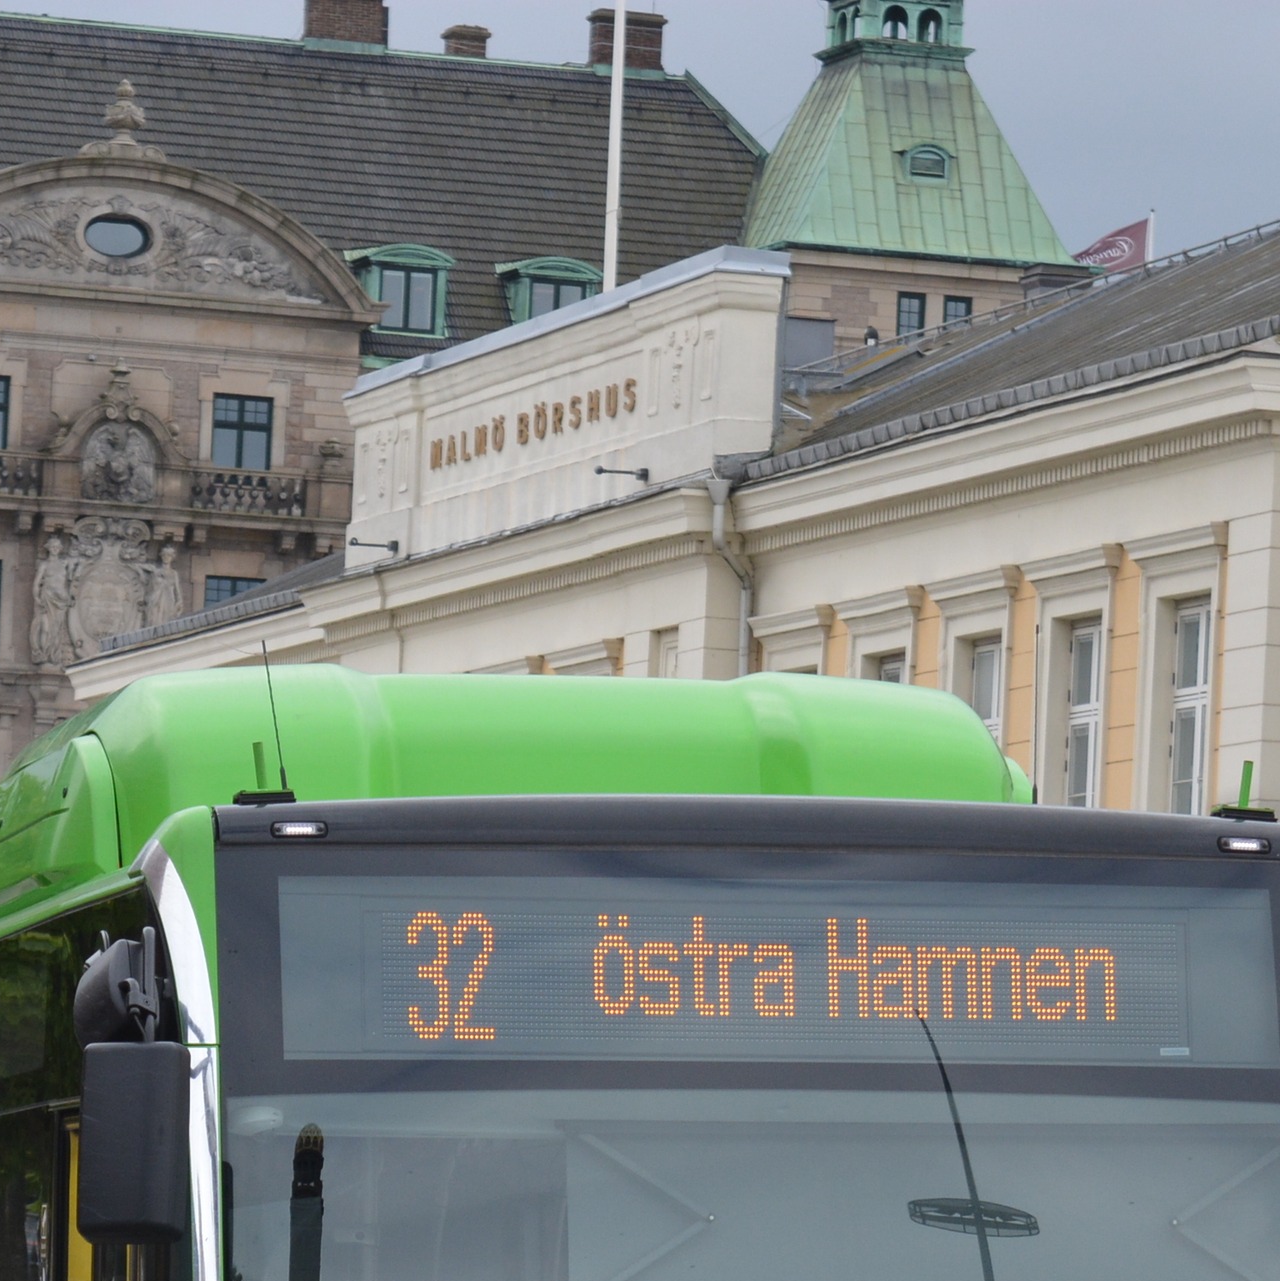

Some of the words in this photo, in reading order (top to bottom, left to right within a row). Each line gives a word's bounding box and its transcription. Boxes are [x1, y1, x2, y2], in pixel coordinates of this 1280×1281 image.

[430, 414, 505, 470] MALMÖ
[516, 378, 637, 445] BÖRSHUS
[407, 911, 495, 1040] 32
[593, 914, 796, 1017] Östra
[826, 917, 1117, 1021] Hamnen
